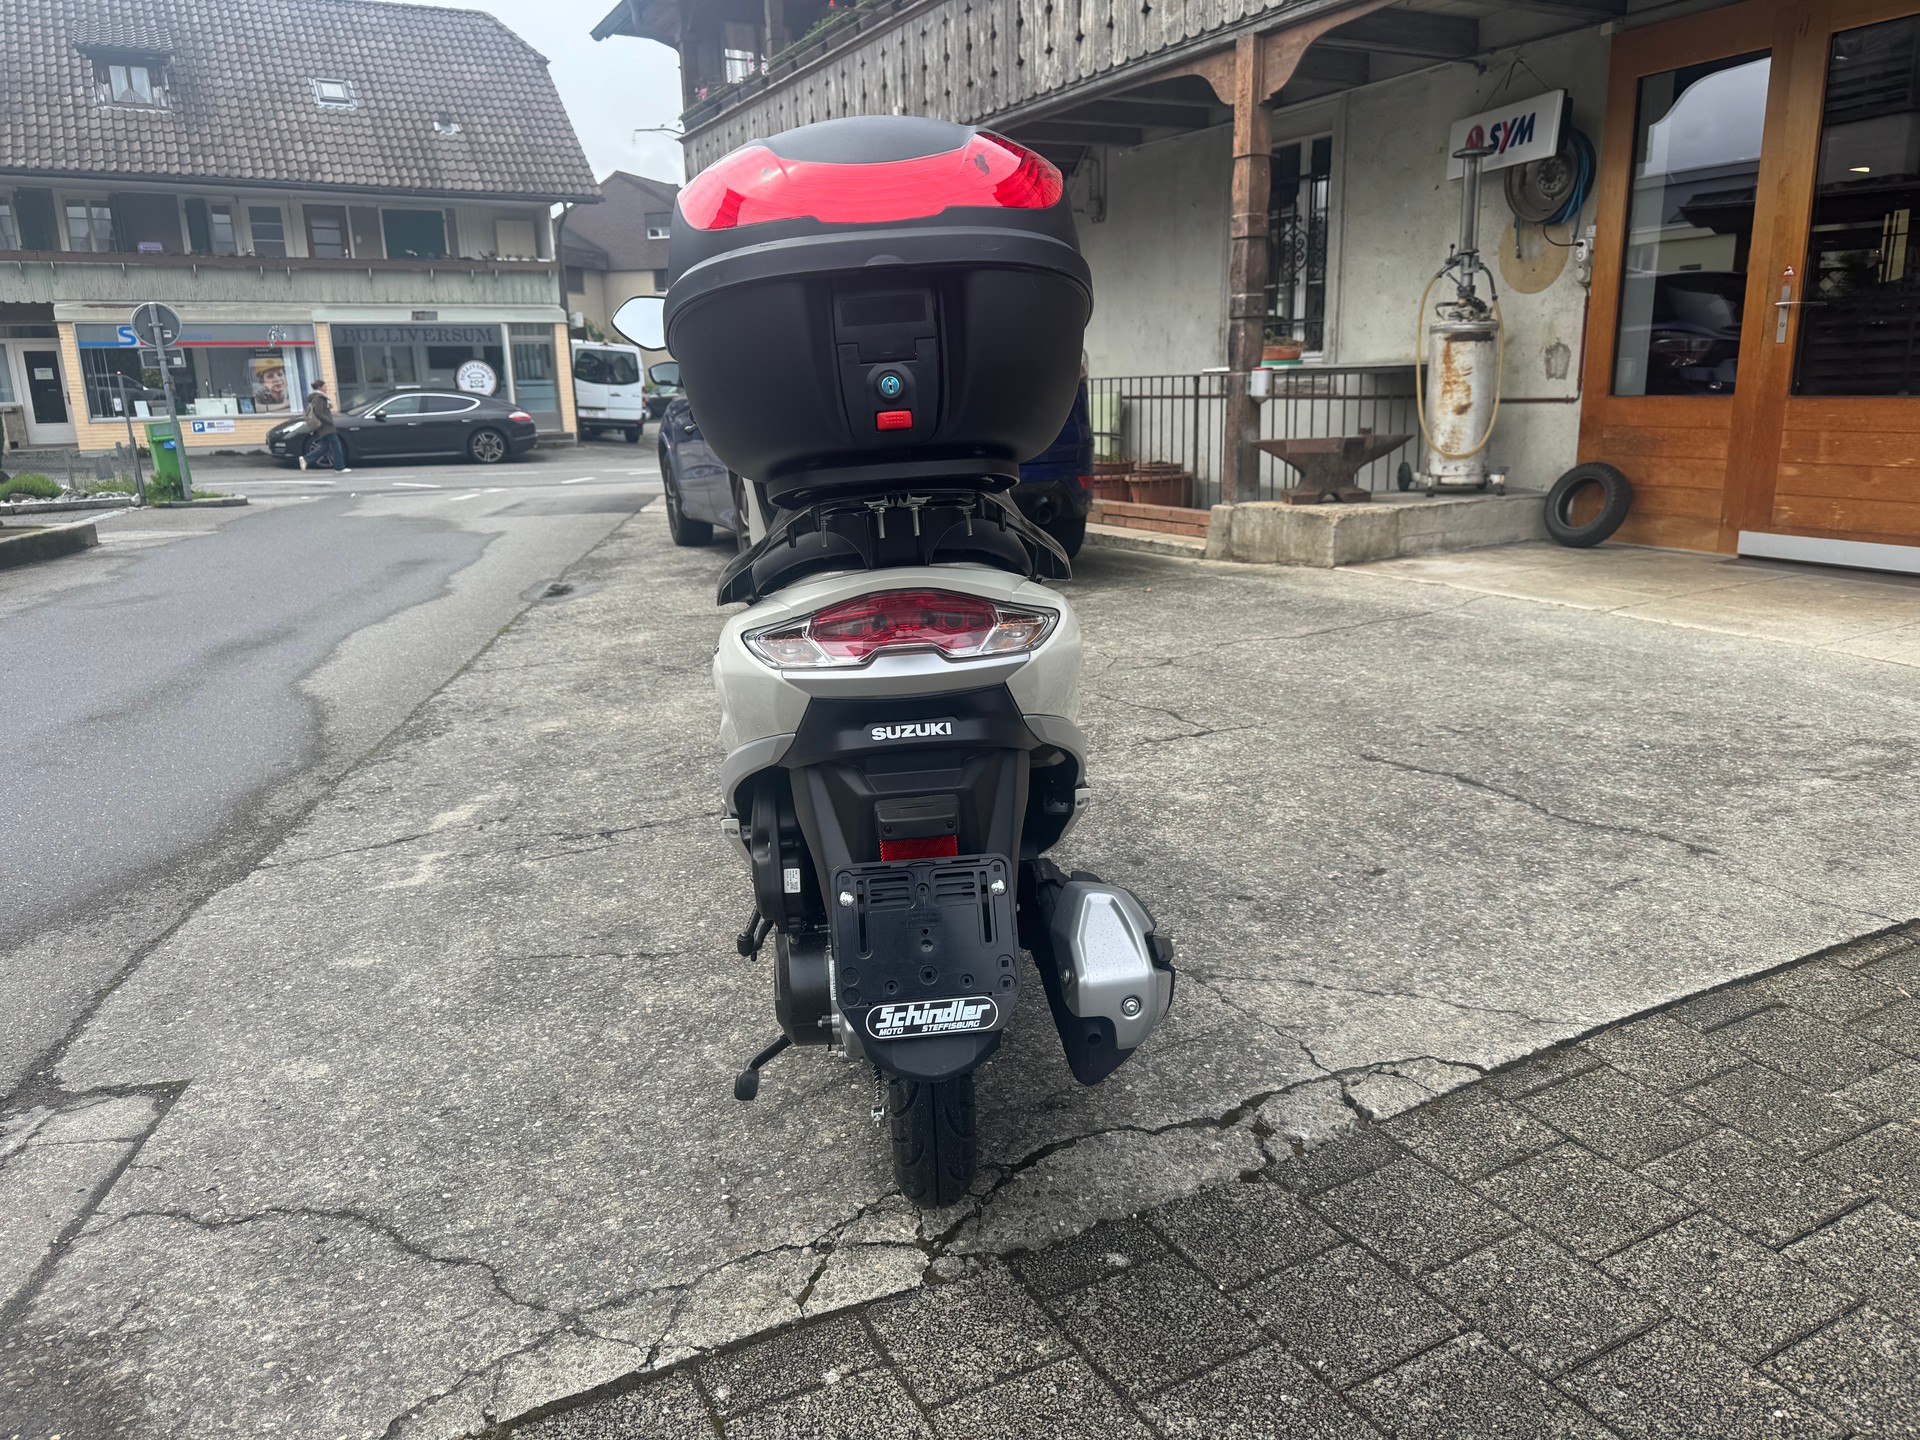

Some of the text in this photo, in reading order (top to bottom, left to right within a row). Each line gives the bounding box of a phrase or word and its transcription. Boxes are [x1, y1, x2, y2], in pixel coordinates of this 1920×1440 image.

[1488, 112, 1536, 154] SYM
[341, 327, 494, 343] BULLIVERSUM
[194, 423, 203, 431] P
[871, 722, 952, 741] SUZUKI
[875, 1000, 991, 1029] Schindler
[878, 1020, 981, 1036] MOTO STEFFISBURG
